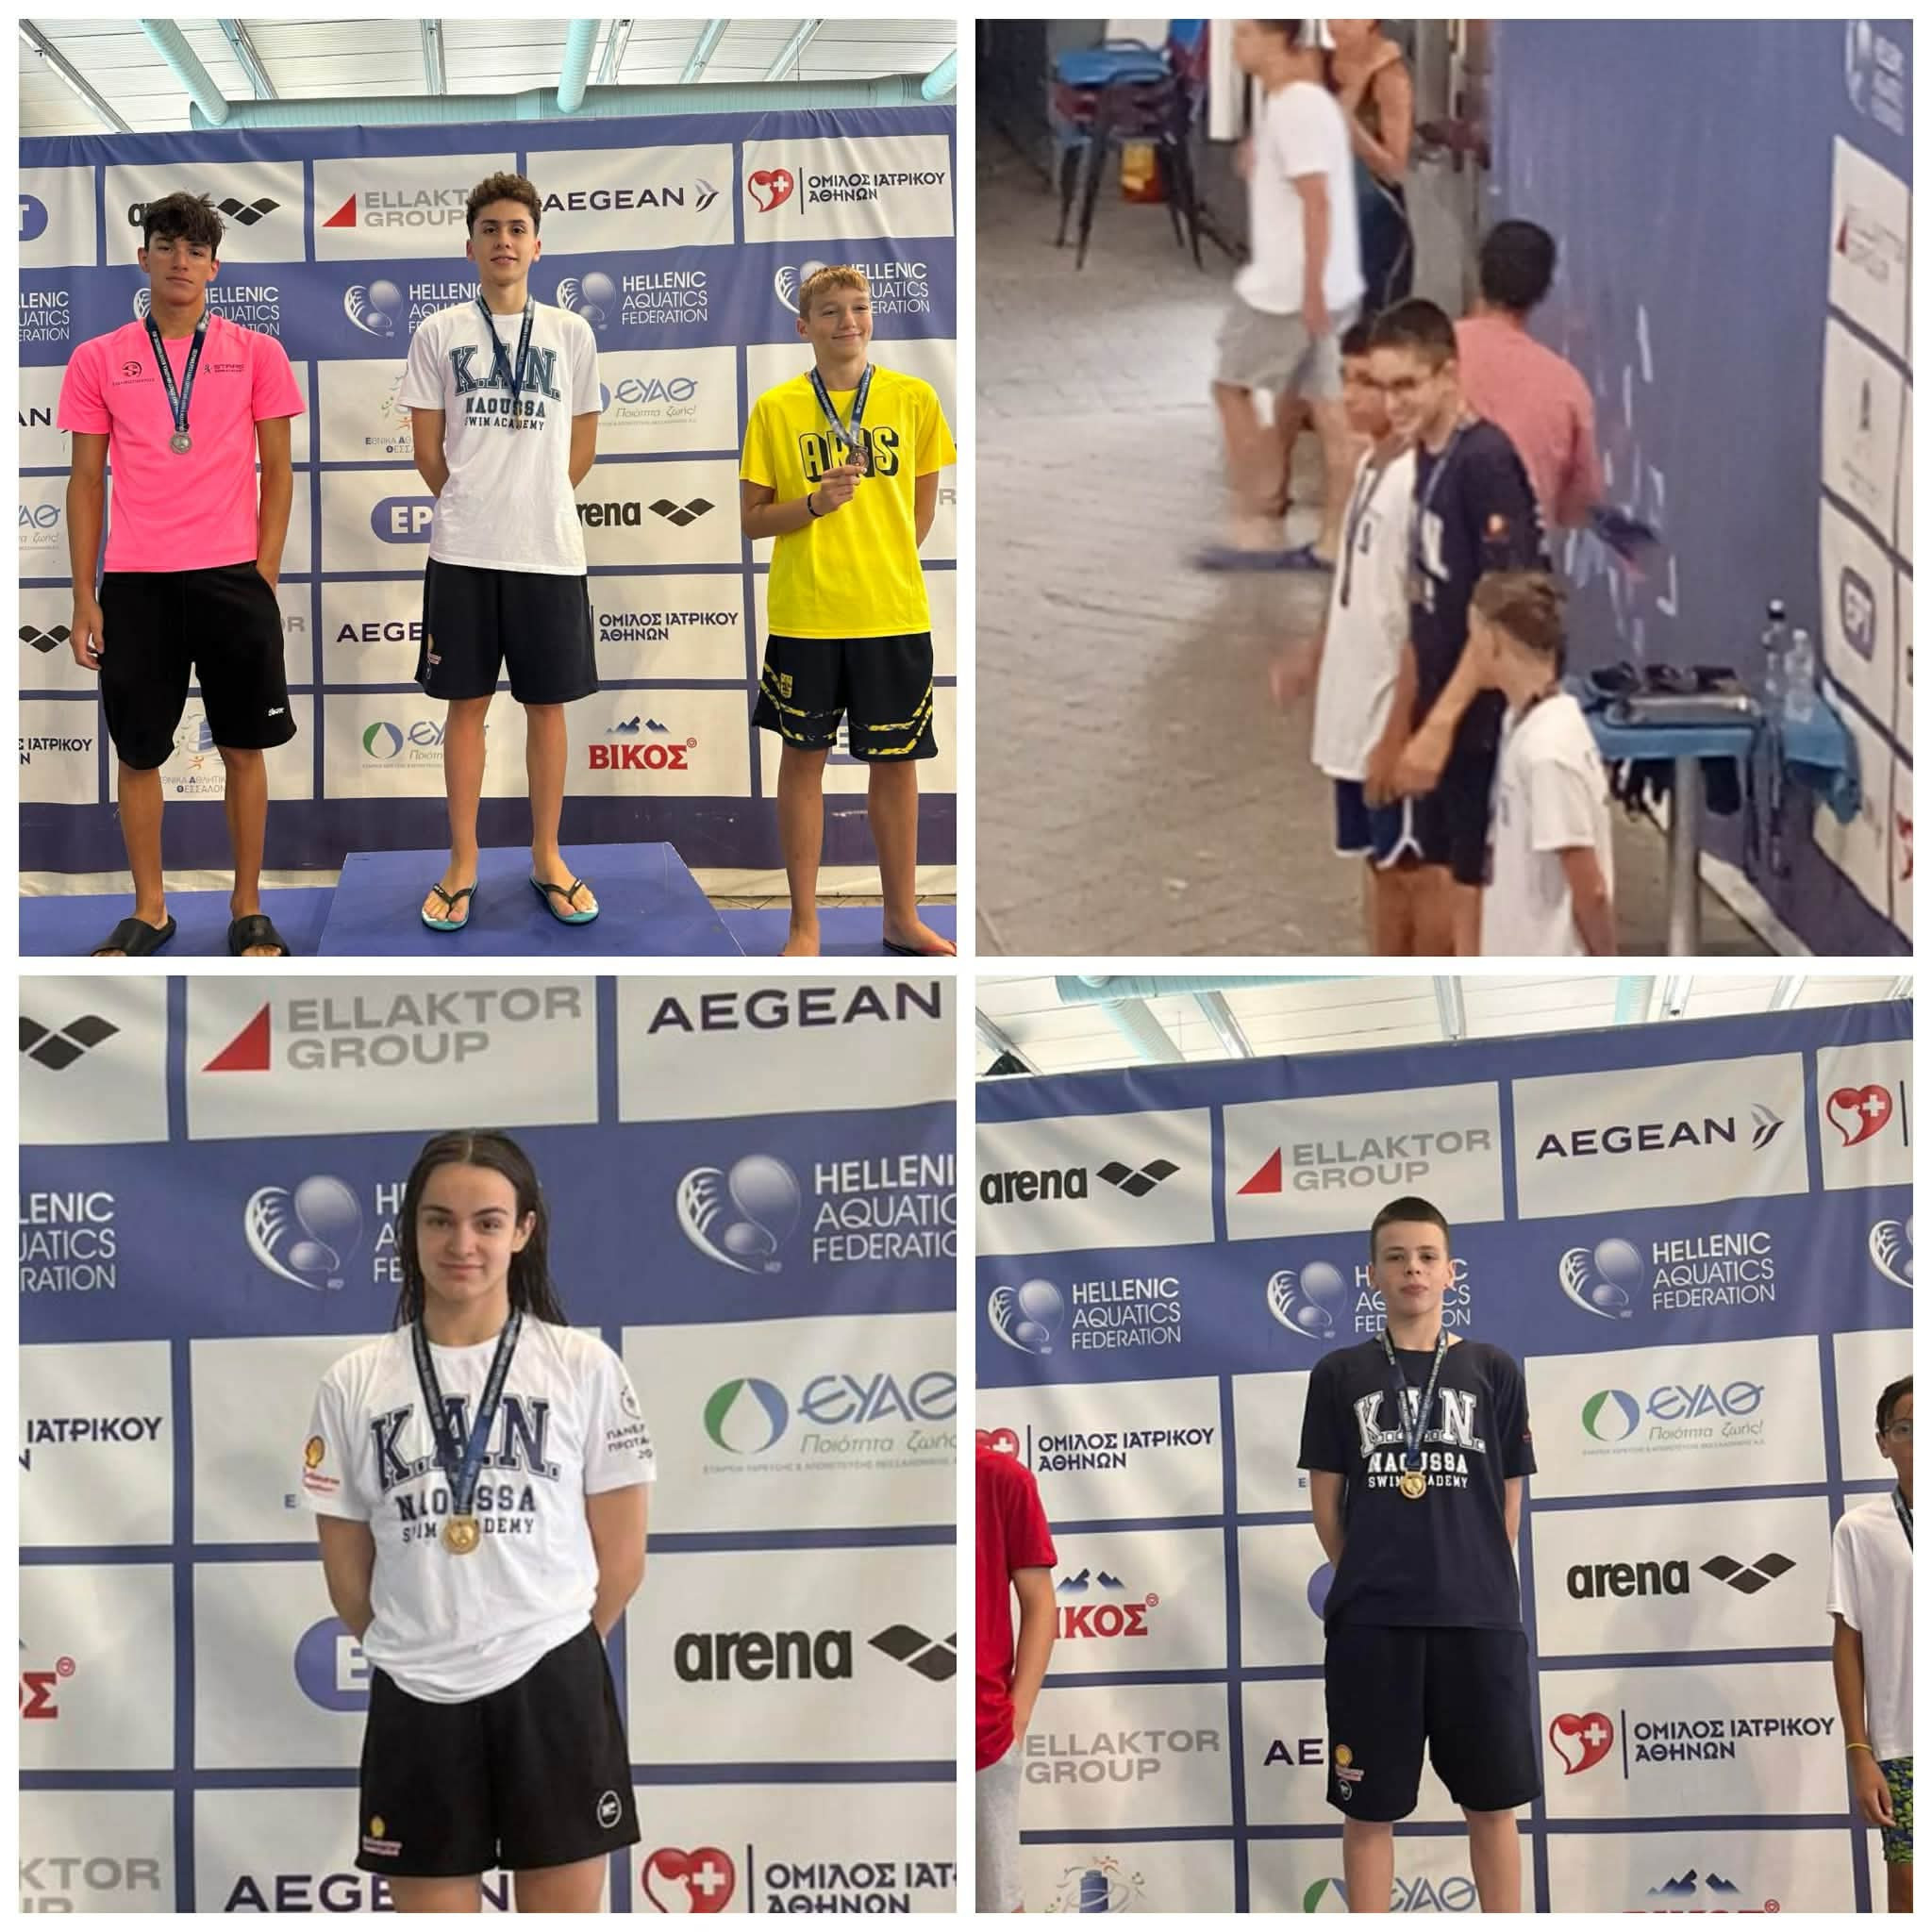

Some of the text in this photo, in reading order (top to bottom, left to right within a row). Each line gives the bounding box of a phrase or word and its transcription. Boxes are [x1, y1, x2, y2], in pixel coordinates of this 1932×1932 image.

[808, 171, 946, 190] ΟΜΙΛΟΣ ΙΑΤΡΙΚΟΥ
[364, 189, 470, 208] ELLAKT
[541, 187, 684, 212] AEGEAN
[808, 188, 878, 204] ΑΘΗΝΩΝ
[364, 209, 468, 227] GROUP
[623, 271, 707, 291] HELLENIC
[845, 261, 927, 280] ELLENIC
[19, 291, 69, 308] LENIC
[622, 289, 708, 310] AQUATICS
[871, 281, 929, 299] UATICS
[622, 307, 708, 325] FEDERATION
[871, 298, 930, 314] ERATION
[449, 341, 561, 402] K.AN.
[466, 396, 546, 418] NAOUSSA
[799, 426, 899, 483] ARS
[19, 504, 60, 528] ΑΘ
[577, 499, 641, 527] rena
[599, 610, 739, 628] ΟΜΙΛΟΣ ΙΑΤΡΙΚΟΥ
[336, 623, 424, 643] AEGE
[599, 627, 670, 642] ΑΘΗΝΩΝ
[27, 737, 92, 753] ΙΑΤΡΙΚΟΥ
[288, 986, 582, 1033] ELLAKTOR
[647, 981, 941, 1035] AEGEAN
[287, 1029, 489, 1070] GROUP
[1292, 1128, 1491, 1167] ELLAKTOR
[1536, 1117, 1736, 1160] AEGEAN
[814, 1154, 957, 1196] HELLENI
[979, 1165, 1089, 1205] arena
[1292, 1160, 1430, 1192] GROUP
[1653, 1231, 1772, 1265] HELLENIC
[1652, 1257, 1774, 1290] AQUATICS
[1072, 1275, 1180, 1304] HELLENIC
[1652, 1283, 1775, 1310] FEDERATION
[1072, 1301, 1181, 1329] AQUATICS
[1072, 1326, 1182, 1351] FEDERATION
[26, 1416, 163, 1443] ΙΑΤΡΙΚΟΥ
[1038, 1427, 1215, 1453] ΟΜΙΛΟΣ ΙΑΤΡΙΚΟΥ
[1038, 1452, 1127, 1473] ΑΘΗΝΩΝ
[1426, 1474, 1469, 1490] ADEMY
[395, 1483, 536, 1523] NAOSSA
[475, 1516, 535, 1537] DEMY
[1566, 1559, 1690, 1600] arena
[1056, 1604, 1148, 1640] ΙΚΟΣ
[674, 1629, 853, 1682] arena
[1634, 1717, 1836, 1741] ΟΜΙΛΟΣ ΙΑΤΡΙΚΟΥ
[1025, 1728, 1221, 1757] ELLAKTOR
[1634, 1740, 1737, 1763] ΑΘΗΝΩΝ
[1025, 1758, 1161, 1785] GROUP
[765, 1863, 895, 1889] ΟΜΙΛΟΣ
[224, 1873, 509, 1913] AEGEN
